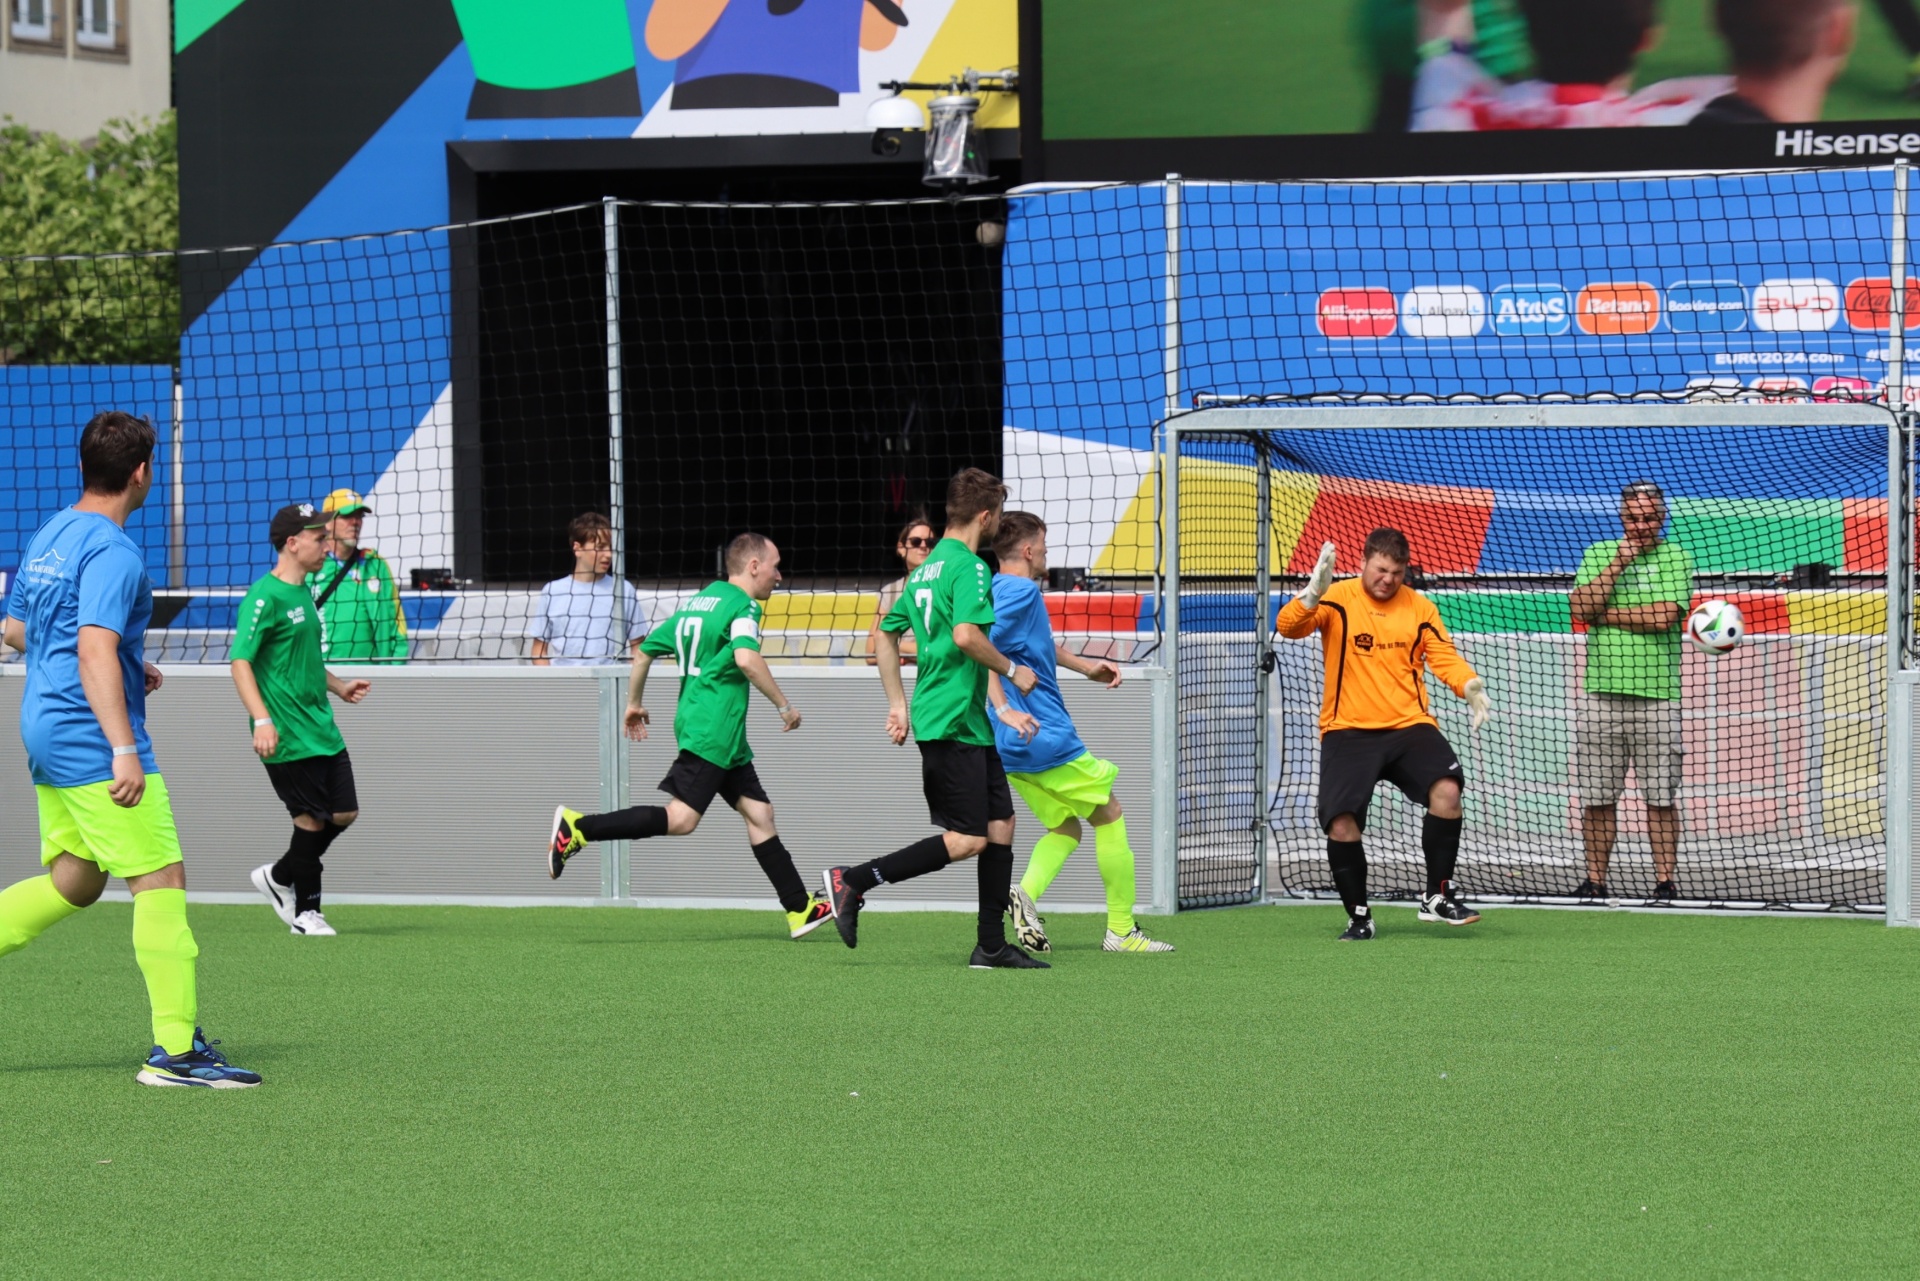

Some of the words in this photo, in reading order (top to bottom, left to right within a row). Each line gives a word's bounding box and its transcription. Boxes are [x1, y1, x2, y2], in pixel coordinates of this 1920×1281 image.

[1775, 129, 1920, 156] Hisense
[1320, 304, 1397, 324] AliExpress
[1585, 298, 1651, 313] Betano
[1668, 300, 1744, 314] Booking.com
[1715, 353, 1845, 365] EURO2024.com
[1865, 348, 1920, 362] #ERO
[915, 588, 933, 636] 7
[675, 616, 703, 676] 12
[832, 869, 843, 893] FILA
[871, 867, 884, 884] JAKO
